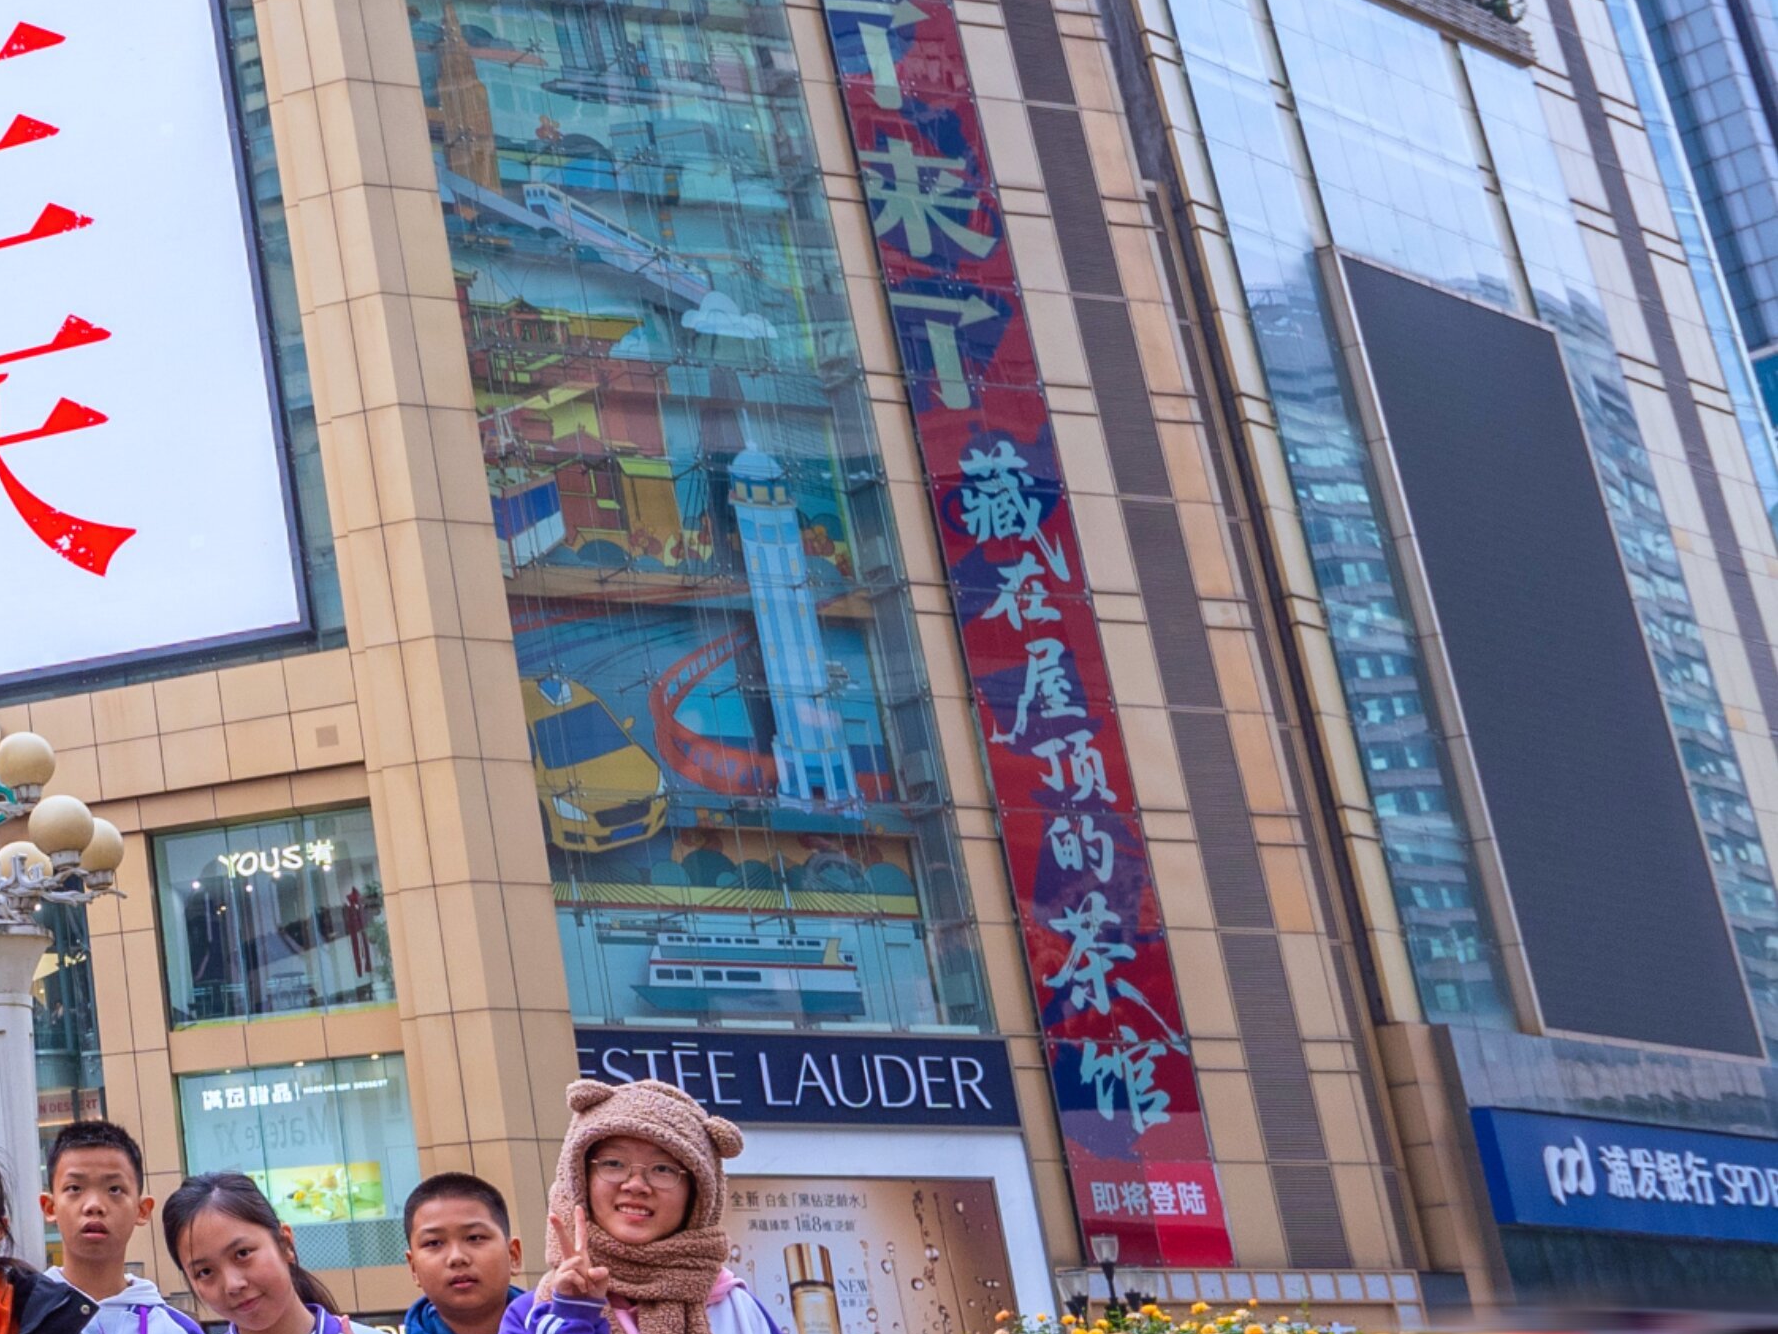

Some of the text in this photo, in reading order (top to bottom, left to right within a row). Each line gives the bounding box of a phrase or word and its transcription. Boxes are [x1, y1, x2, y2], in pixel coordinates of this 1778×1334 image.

[218, 845, 304, 879] YOUS
[758, 1052, 992, 1110] LAUDER
[1599, 1144, 1716, 1206] 浦发银行
[730, 1191, 760, 1209] 全新
[1091, 1180, 1207, 1216] 即将登陆
[838, 1279, 867, 1294] NEW
